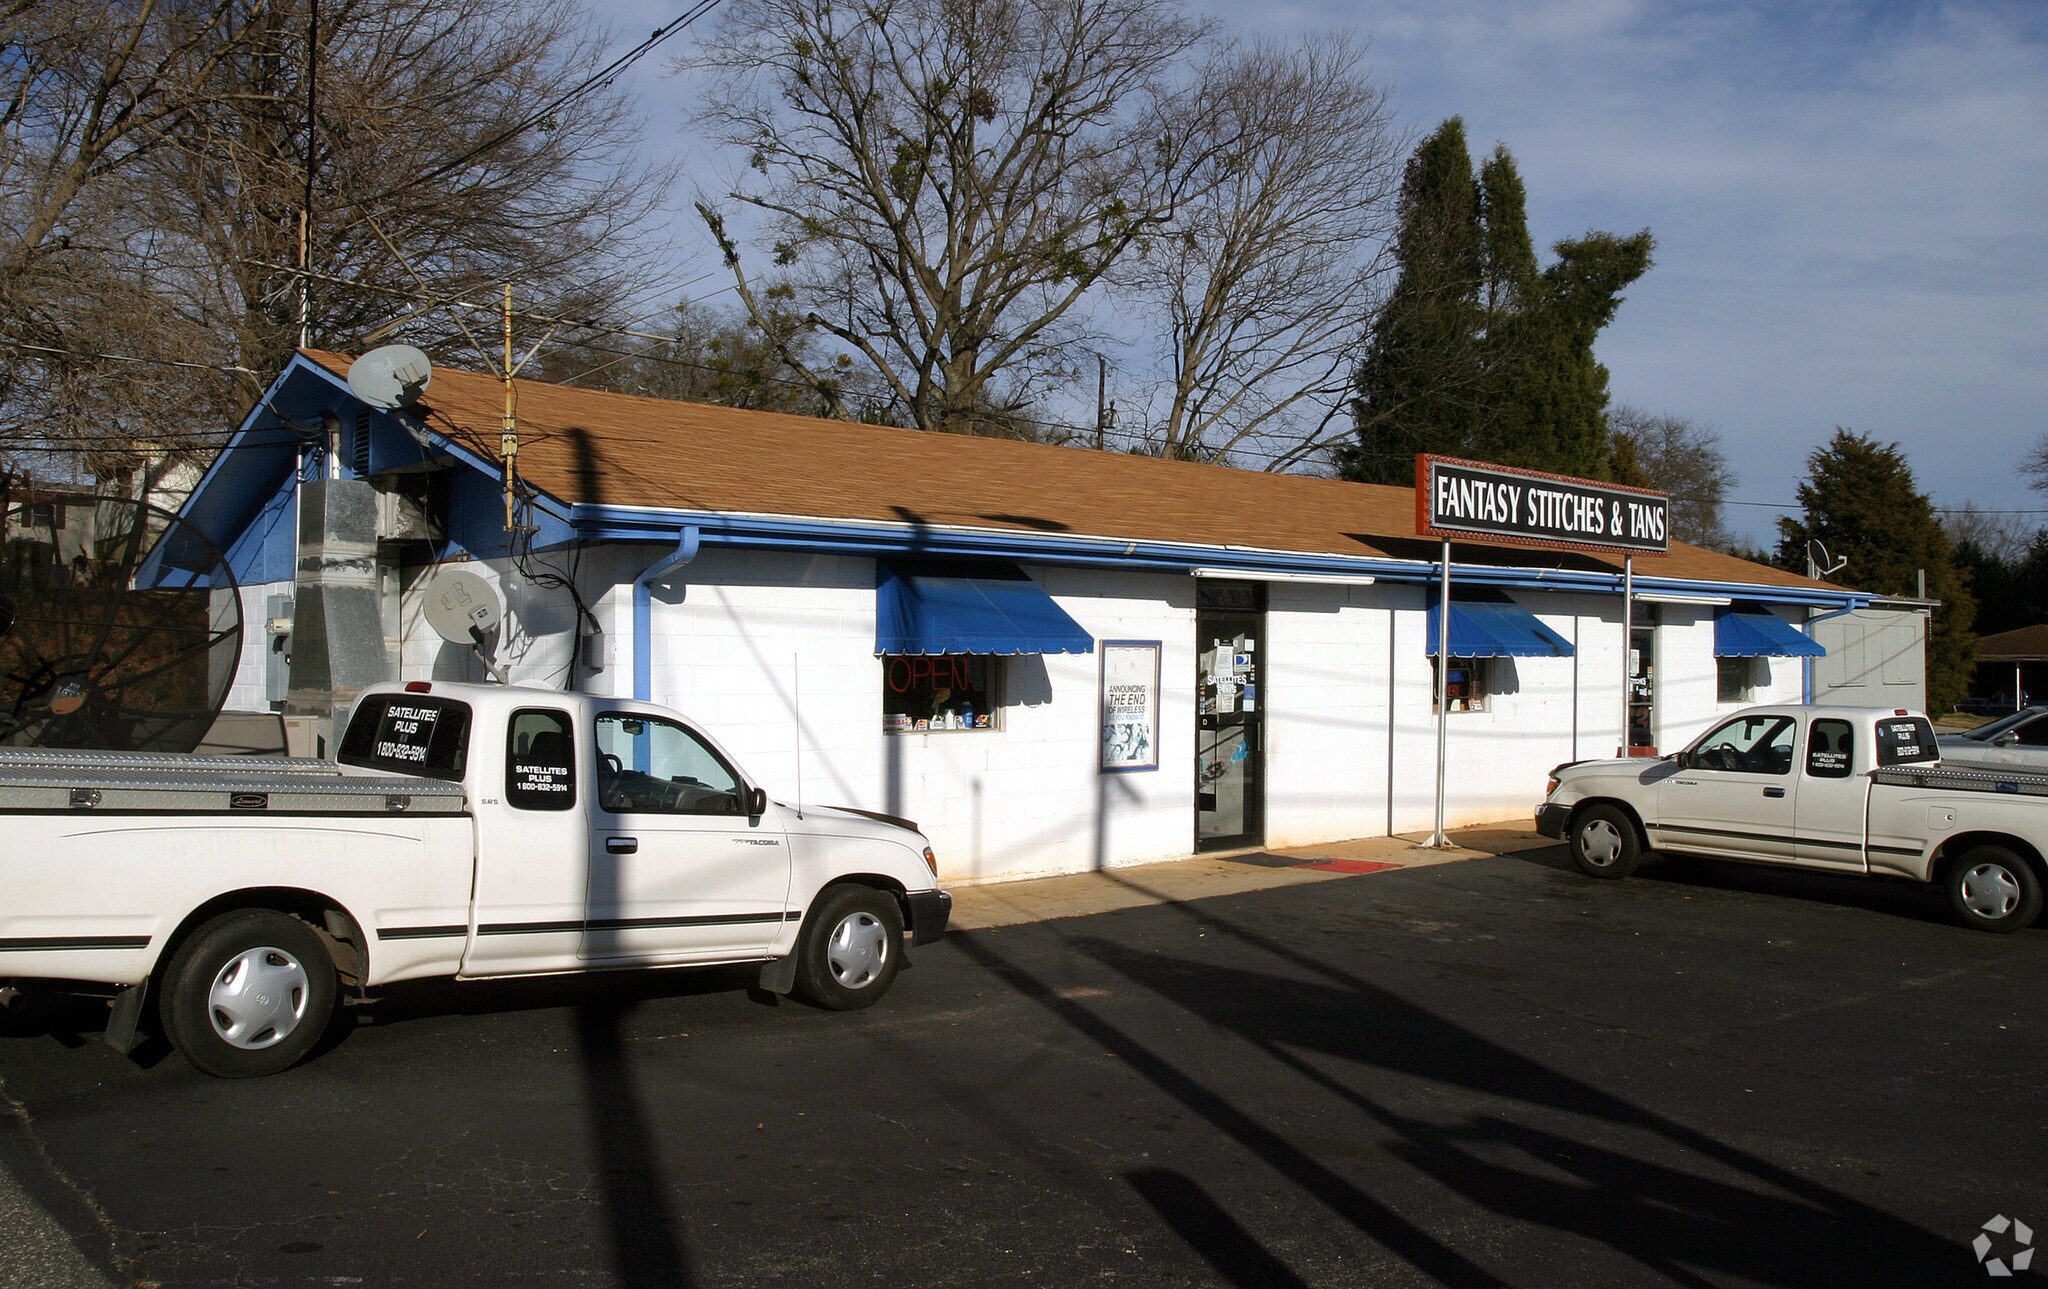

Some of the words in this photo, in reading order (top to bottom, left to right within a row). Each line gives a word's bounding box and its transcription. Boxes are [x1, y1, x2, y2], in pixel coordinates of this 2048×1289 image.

[1437, 475, 1521, 525] FANTASY
[1527, 487, 1604, 535] STITCHES
[1610, 500, 1623, 537] &
[1628, 502, 1665, 542] TANS
[889, 656, 968, 693] OPEN
[1207, 674, 1247, 686] SATELLITES
[1108, 684, 1146, 694] ANNOUNCING
[1217, 685, 1237, 694] PLUS
[1109, 693, 1126, 706] THE
[1127, 693, 1146, 706] END
[387, 706, 438, 721] SATELLITES
[1108, 706, 1116, 714] OF
[1116, 705, 1146, 714] WIRELESS
[394, 720, 418, 734] PLUS
[515, 765, 568, 776] SATELLITES
[528, 774, 552, 783] PLUS
[517, 782, 521, 790] 1
[522, 782, 567, 792] 800-832-5914
